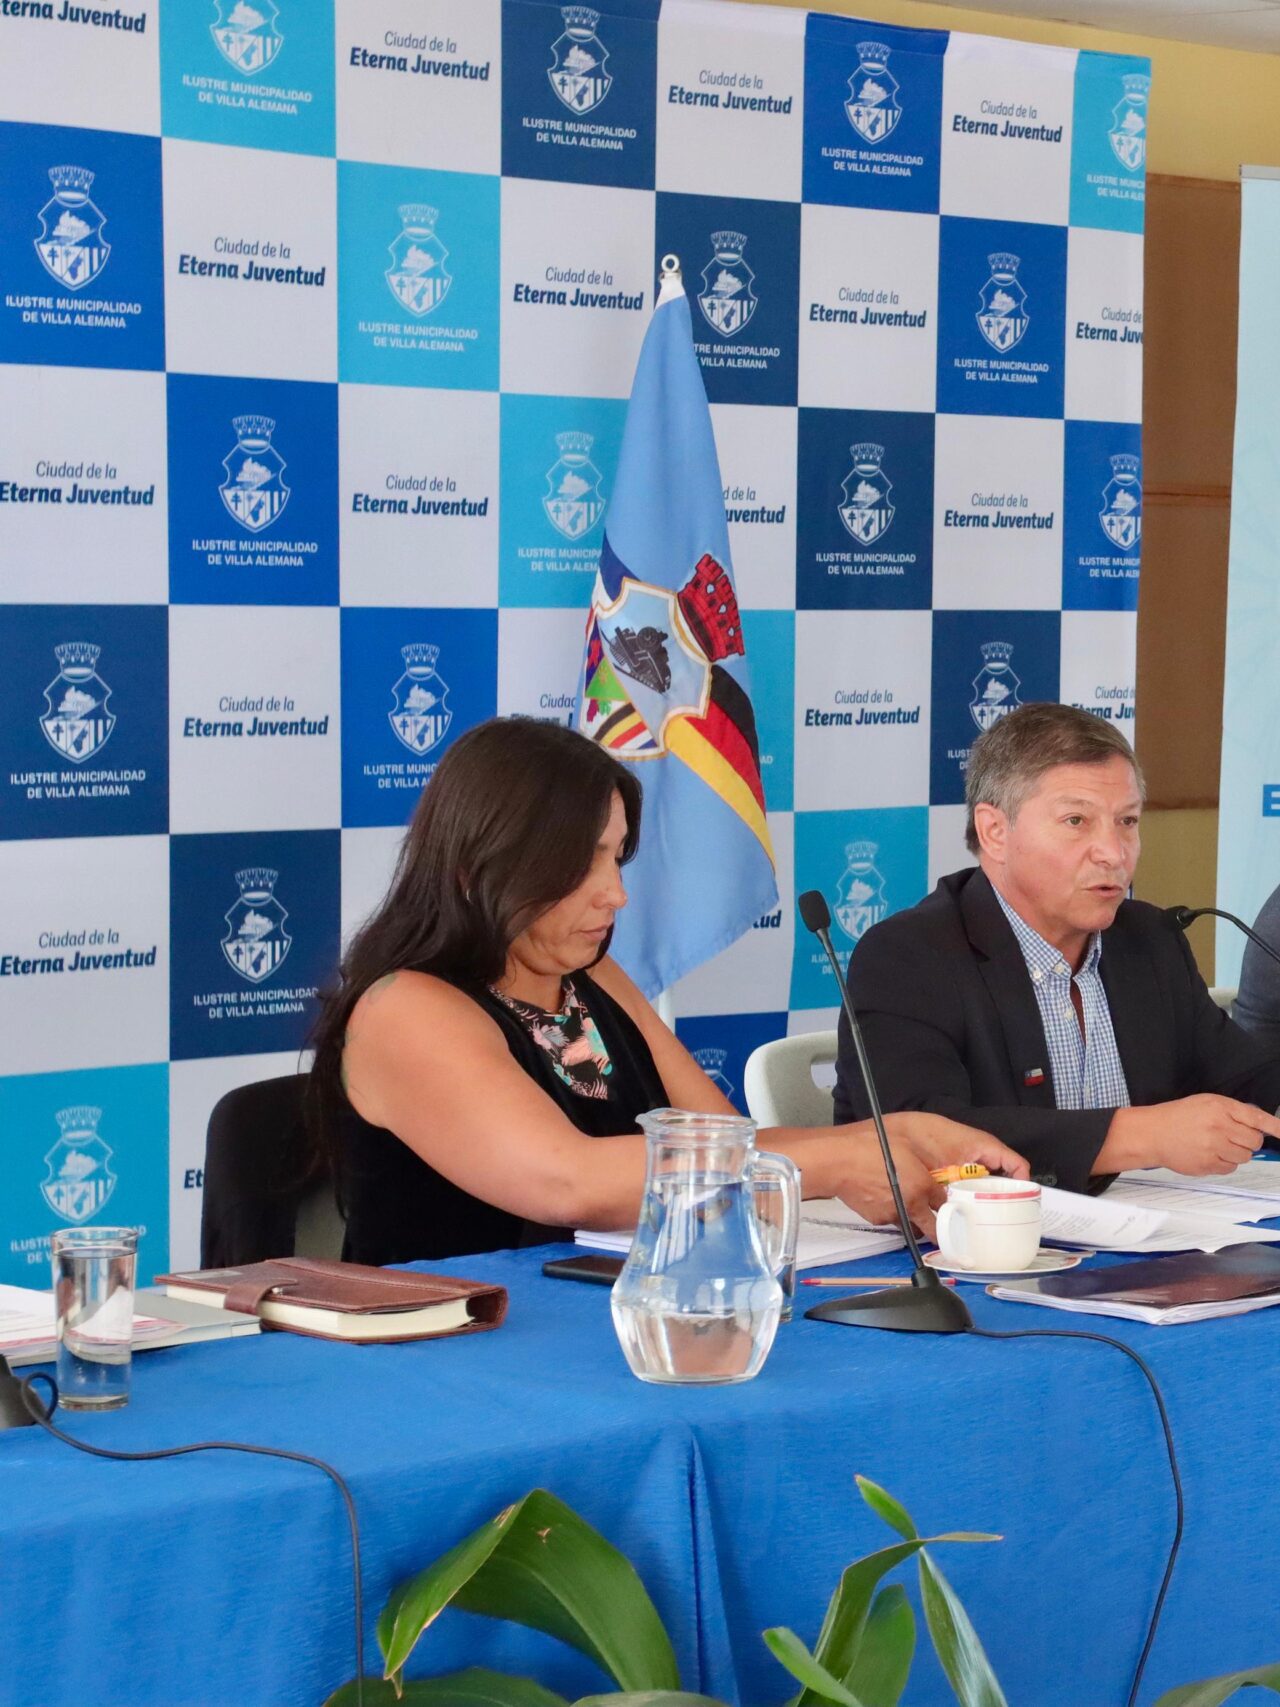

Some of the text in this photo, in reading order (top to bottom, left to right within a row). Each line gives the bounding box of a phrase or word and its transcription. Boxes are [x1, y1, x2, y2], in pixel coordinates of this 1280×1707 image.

[0, 0, 145, 33] terna Juventud
[385, 31, 456, 52] Ciudad de la
[350, 47, 490, 80] Eterna Juventud
[182, 73, 313, 103] ILUSTRE MUNICIPALIDAD
[700, 70, 762, 88] Ciudad de la
[198, 90, 298, 115] DE VILLA ALEMANA
[668, 86, 792, 114] Eterna Juventud
[981, 100, 1037, 118] Ciudad de la
[522, 117, 637, 139] ILUSTRE MUNICIPALIDAD
[952, 115, 1062, 142] Eterna Juventud
[535, 131, 624, 151] DE VILLA ALEMANA
[821, 147, 924, 166] ILUSTRE MUNICIPALIDAD
[833, 160, 912, 177] DE VILLA ALEMANA
[214, 237, 291, 259] Ciudad de la
[179, 254, 325, 286] Eterna Juventud
[545, 267, 613, 285] Ciudad de la
[5, 295, 142, 315] ILUSTRE MUNICIPALIDAD
[514, 284, 644, 310] Eterna Juventud
[839, 287, 899, 305] Ciudad de la
[22, 310, 127, 329] DE VILLA ALEMANA
[810, 304, 926, 328] Eterna Juventud
[1101, 307, 1131, 321] Ciudad
[358, 321, 479, 340] ILUSTRE MUNICIPALIDAD
[1076, 322, 1116, 341] Eterna
[373, 335, 465, 352] DE VILLA ALEMANA
[713, 345, 781, 357] MUNICIPALIDAD
[700, 357, 768, 369] VILLA ALEMANA
[953, 358, 1050, 373] ILUSTRE MUNICIPALIDAD
[965, 370, 1038, 384] DE VILLA ALEMANA
[35, 461, 117, 479] Ciudad de la
[385, 475, 457, 492] Ciudad de la
[0, 482, 154, 505] Eterna Juventud
[732, 487, 744, 501] de
[746, 487, 756, 501] la
[972, 493, 1028, 507] Ciudad de la
[352, 494, 488, 516] Eterna Juventud
[726, 505, 786, 523] uventud
[944, 510, 1054, 529] Eterna Juventud
[192, 539, 319, 553] ILUSTRE MUNICIPALIDAD
[518, 548, 557, 558] ILUSTRE
[207, 553, 304, 567] DE VILLA ALEMANA
[531, 561, 543, 571] DE
[545, 562, 571, 572] VILLA
[815, 552, 917, 563] ILUSTRE MUNICIPALIDAD
[1079, 557, 1110, 566] ILUSTRE
[827, 565, 905, 575] DE VILLA ALEMANA
[1090, 568, 1100, 577] DE
[1102, 569, 1123, 578] VILLA
[836, 690, 893, 703] Ciudad de la
[1095, 686, 1129, 700] Ciudad
[219, 697, 295, 711] Ciudad de la
[805, 706, 920, 726] Eterna Juventud
[184, 716, 328, 736] Eterna Juventud
[10, 769, 146, 785] ILUSTRE MUNICIPALIDAD
[364, 764, 405, 776] ILUSTRE
[27, 784, 131, 799] DE VILLA ALEMANA
[378, 778, 391, 789] DE
[393, 777, 420, 789] VILLA
[39, 929, 119, 948] Ciudad de la
[0, 946, 156, 976] Eterna Juventud
[193, 992, 238, 1006] ILUSTRE
[208, 1001, 305, 1019] DE VILLA ALEMANA
[27, 1252, 43, 1265] DE
